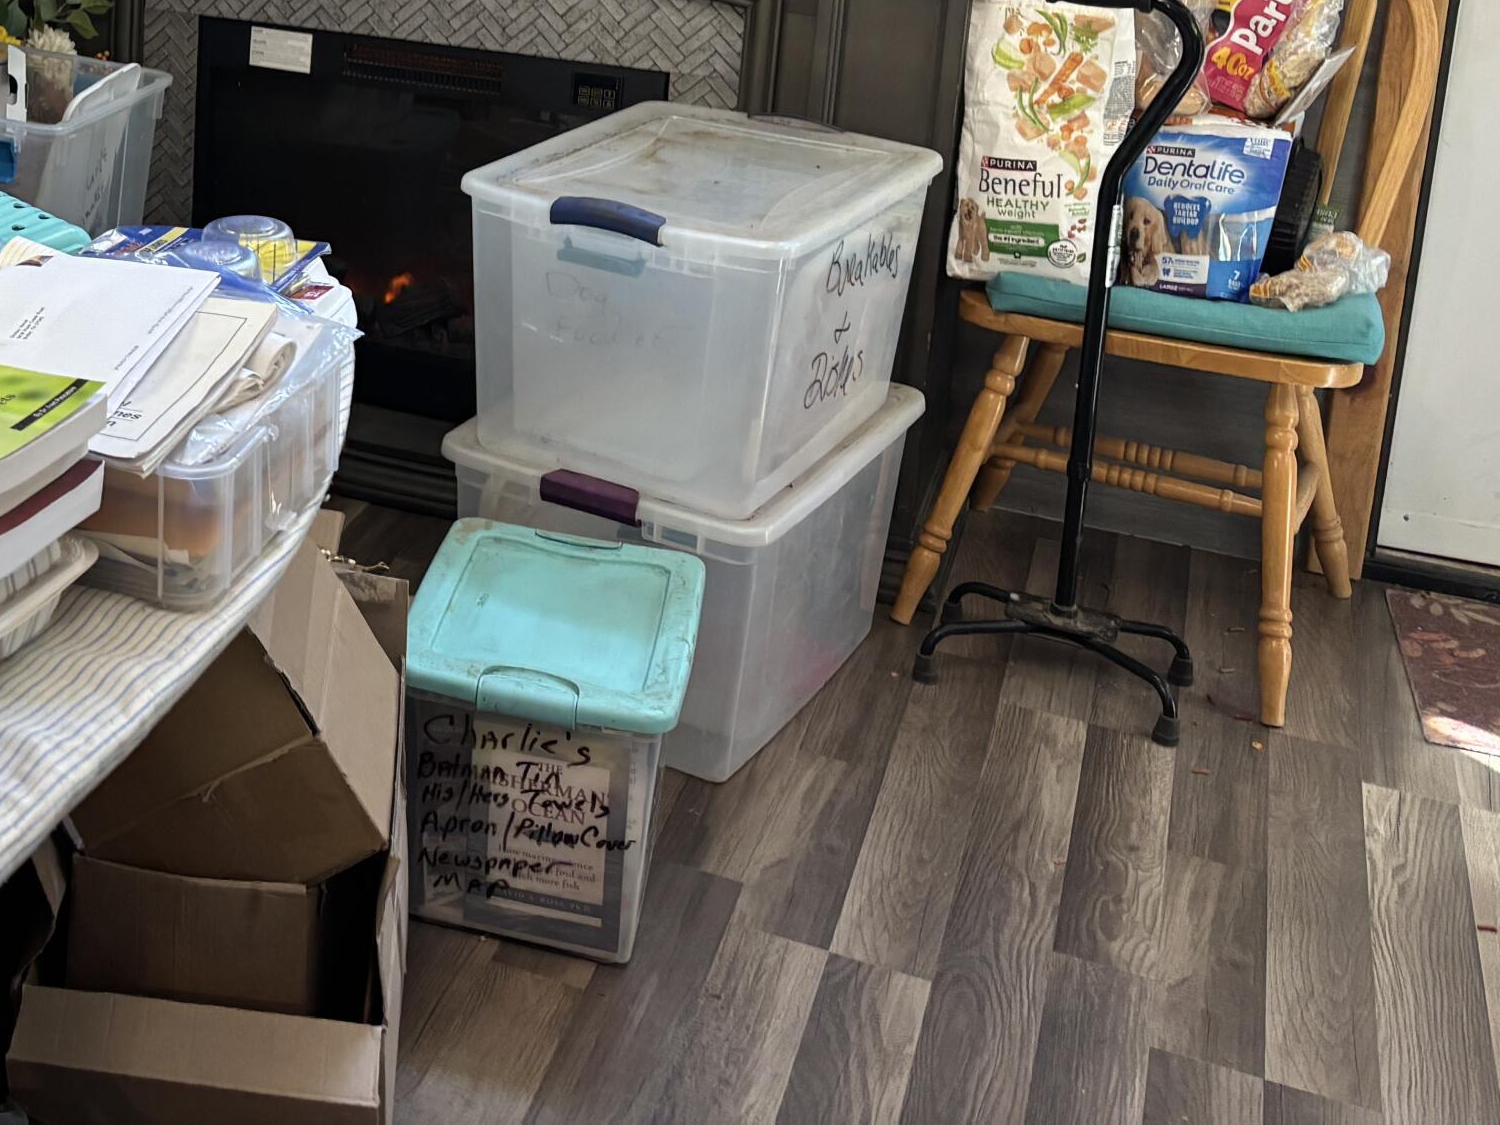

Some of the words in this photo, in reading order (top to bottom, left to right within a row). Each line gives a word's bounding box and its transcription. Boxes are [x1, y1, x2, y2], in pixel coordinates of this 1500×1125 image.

[1157, 147, 1193, 156] PURINA
[989, 159, 1035, 170] PURINA
[978, 168, 1062, 199] Beneful
[1148, 176, 1179, 190] Daily
[1180, 179, 1205, 191] Oral
[1206, 181, 1235, 195] Care
[986, 196, 1050, 212] HEALTHY
[997, 207, 1037, 219] weight
